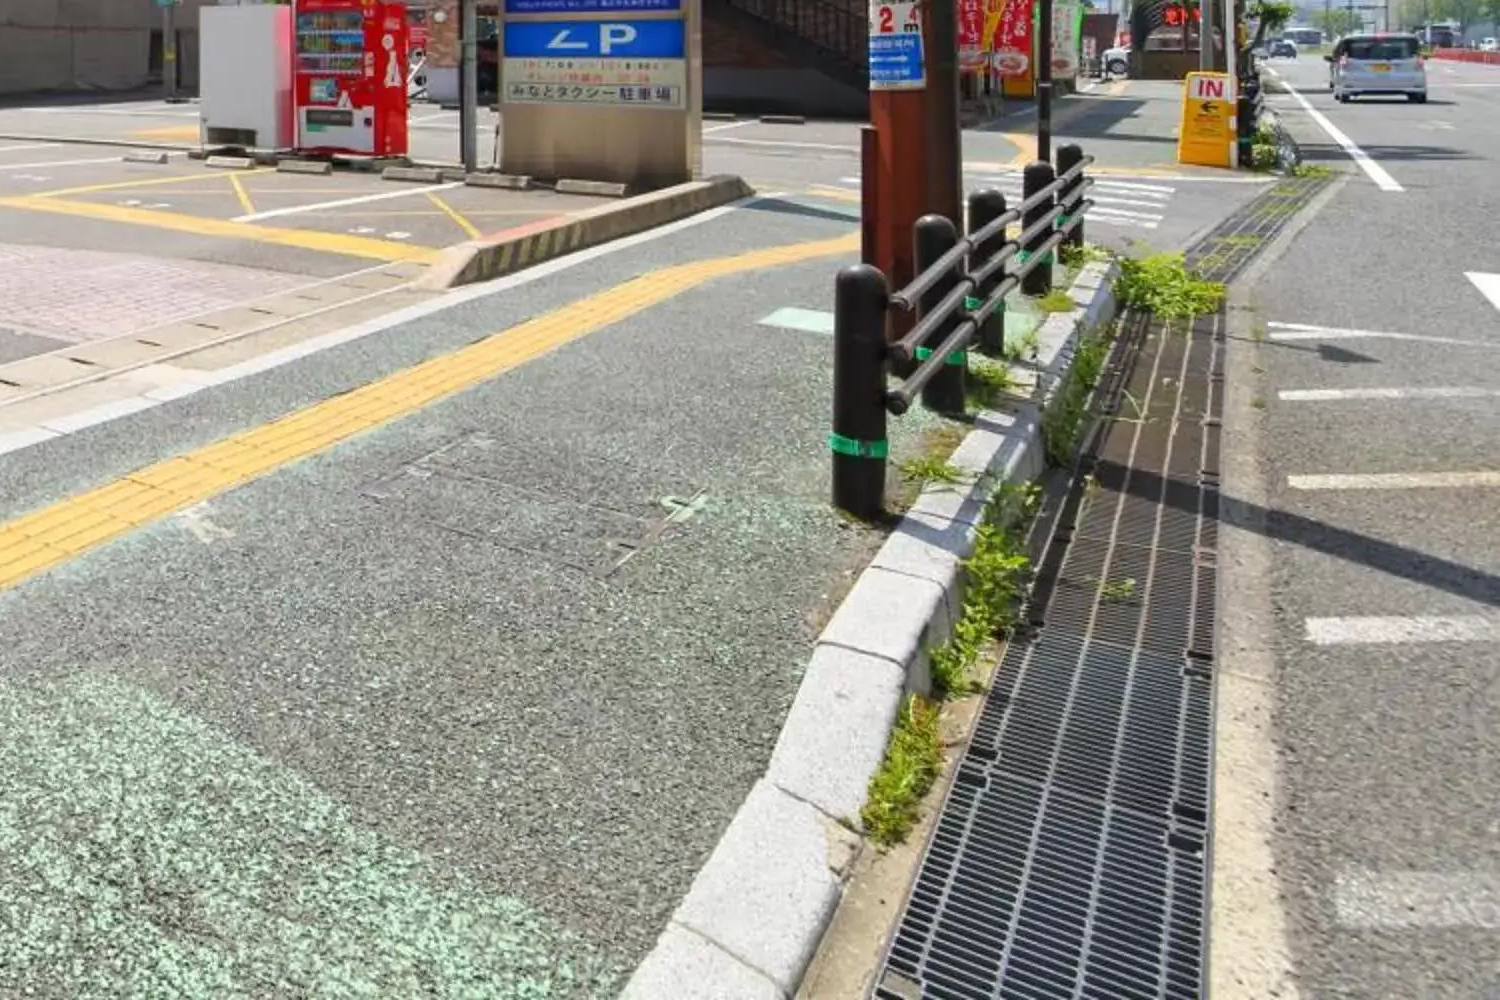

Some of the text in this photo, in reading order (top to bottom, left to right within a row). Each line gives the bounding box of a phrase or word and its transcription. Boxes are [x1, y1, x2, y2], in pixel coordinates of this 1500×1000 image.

[878, 6, 894, 33] 2
[600, 23, 638, 55] P
[1198, 78, 1223, 98] IN
